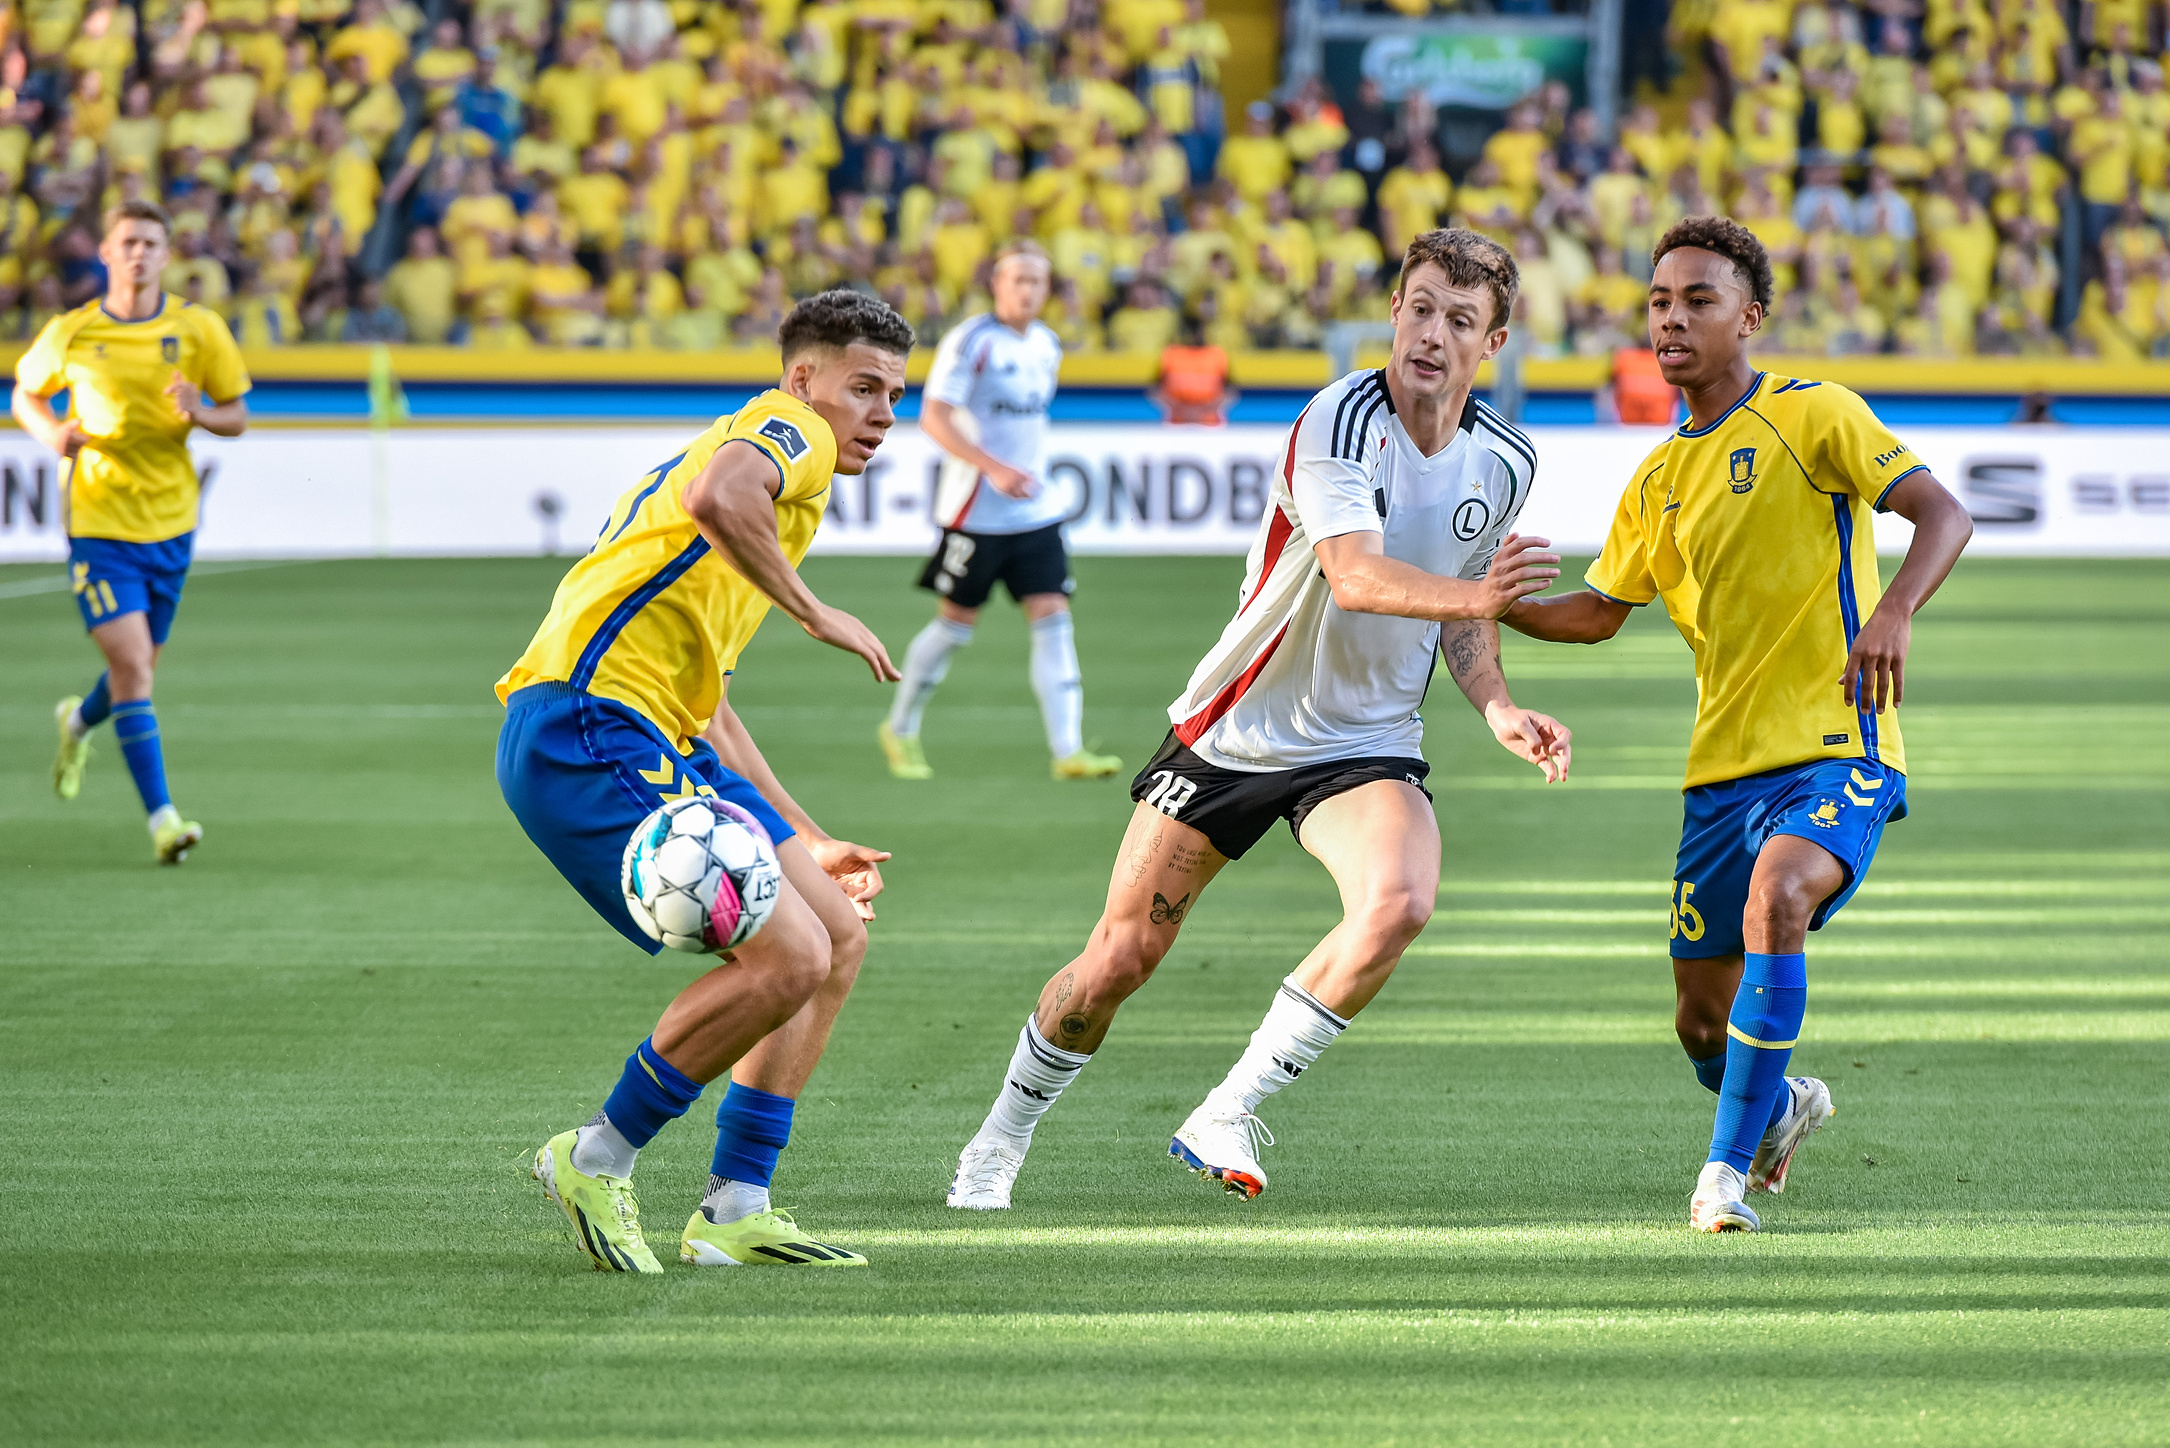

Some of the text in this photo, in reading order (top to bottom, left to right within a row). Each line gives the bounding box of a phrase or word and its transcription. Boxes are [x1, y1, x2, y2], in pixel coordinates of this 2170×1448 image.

[1873, 444, 1909, 469] Boo
[1461, 506, 1476, 534] L
[85, 579, 119, 619] 11
